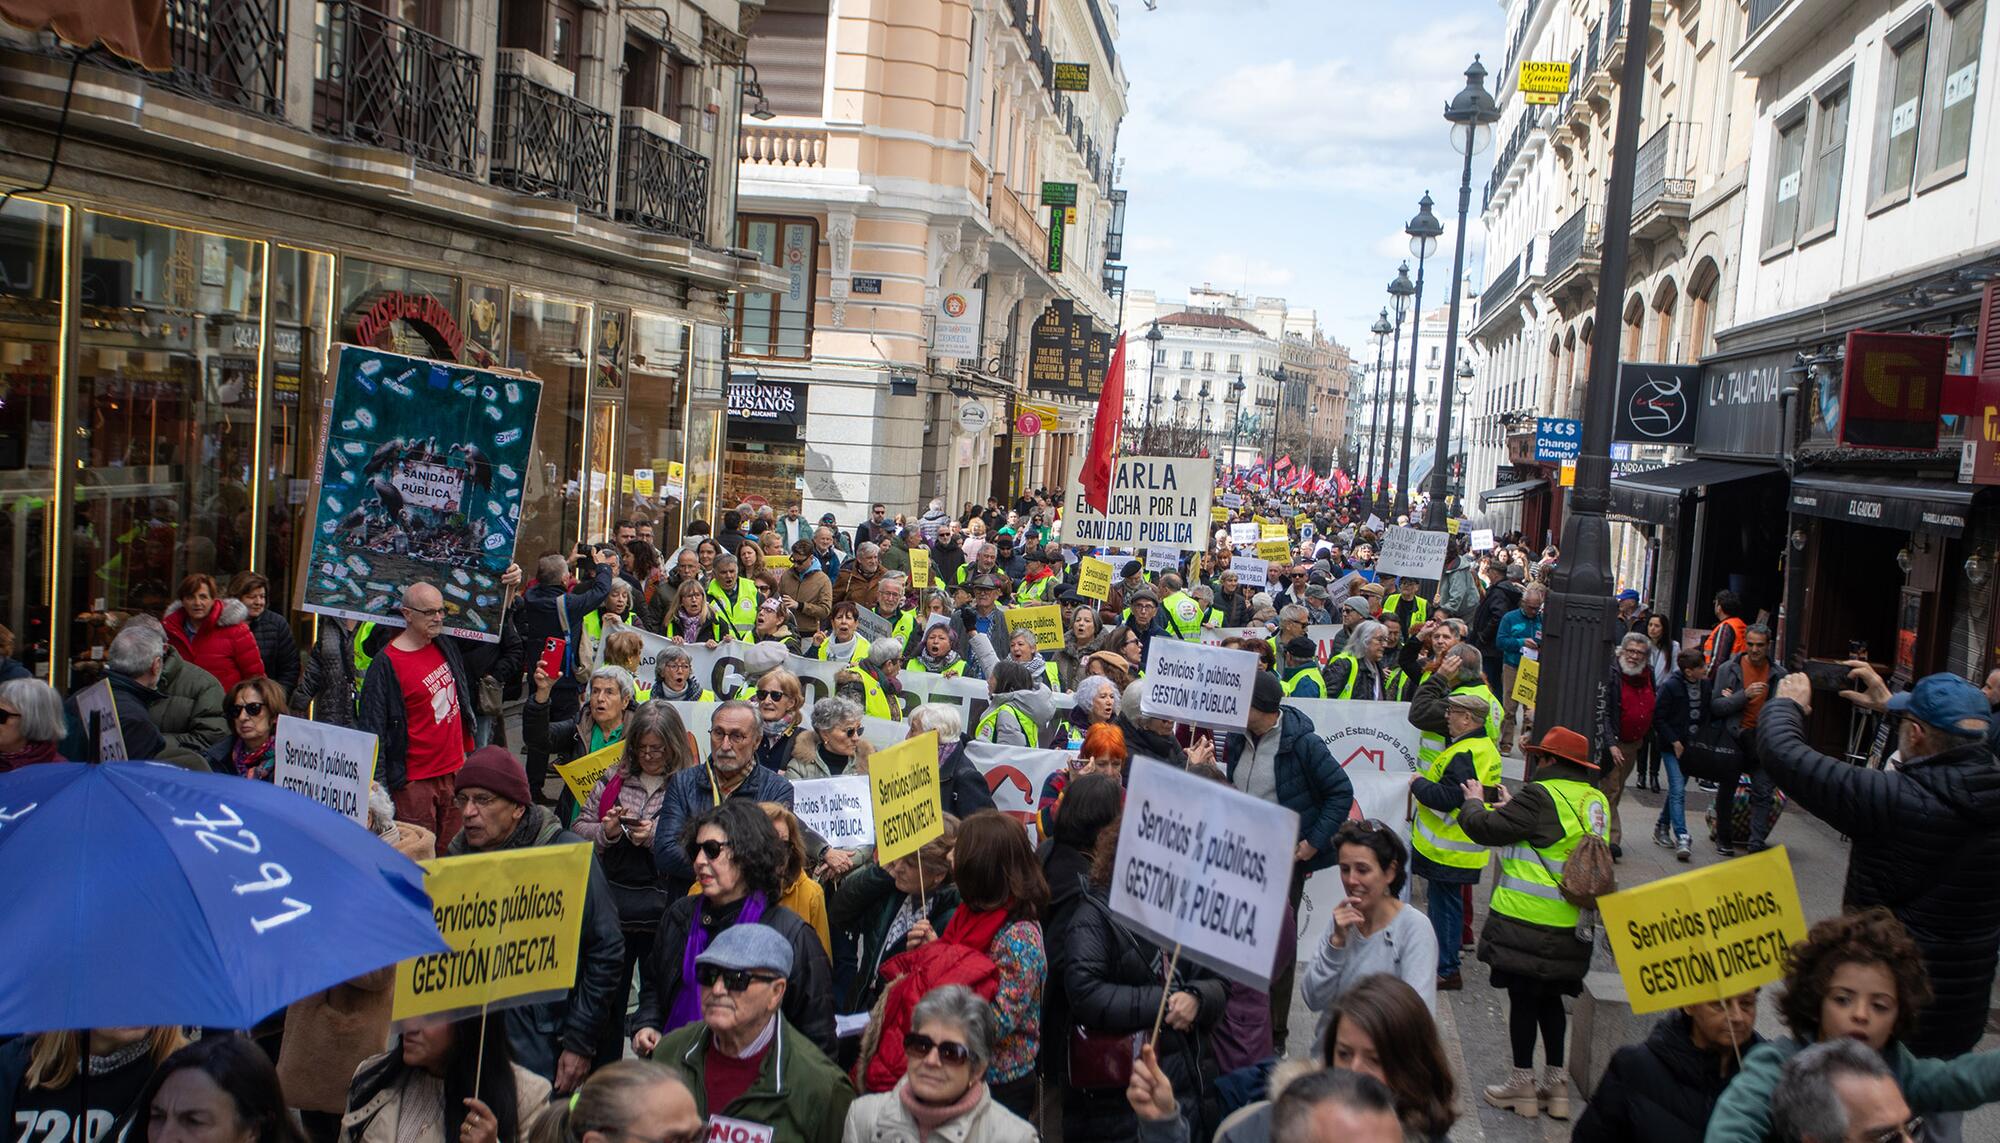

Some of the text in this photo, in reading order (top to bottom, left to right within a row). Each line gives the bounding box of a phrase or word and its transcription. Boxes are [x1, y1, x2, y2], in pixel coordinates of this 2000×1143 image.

[1523, 62, 1567, 73] HOSTAL
[1050, 208, 1063, 270] BIARRITZ
[727, 384, 792, 399] RRONES
[1709, 367, 1779, 406] LA TAURINA
[1537, 438, 1578, 450] Change
[1538, 448, 1575, 459] Money
[401, 482, 451, 500] PÚBLICA
[403, 468, 455, 485] SANIDAD
[1115, 462, 1178, 491] ARLA
[1109, 495, 1141, 515] UCHA
[1149, 497, 1173, 516] POR
[1180, 497, 1197, 517] LA
[1849, 500, 1882, 519] EL GAUCHO
[1076, 519, 1193, 544] SANIDAD PUBLICA
[452, 627, 485, 641] RECLAMA
[1157, 657, 1242, 690] Servicios % públicos,
[1151, 684, 1239, 716] GESTIÓN % PÚBLICA.
[285, 740, 318, 771] Servicios
[324, 750, 360, 785] públicos,
[1324, 727, 1418, 773] dora Estatal por la Defen
[320, 781, 360, 817] PÚBLICA.
[878, 761, 933, 807] Servicios públicos,
[794, 793, 863, 815] ervicios % públicos,
[829, 816, 866, 838] PÚBLICA.
[882, 803, 916, 848] GESTIÓN
[1138, 800, 1268, 893] Servicios % públicos,
[171, 803, 313, 935] 7291
[433, 883, 566, 936] ervicios públicos,
[1125, 856, 1257, 947] GESTIÓN % PÚBLICA.
[1627, 889, 1784, 951] Servicios públicos,
[412, 933, 559, 996] GESTIÓN DIRECTA.
[1638, 945, 1719, 996] GESTIÓN
